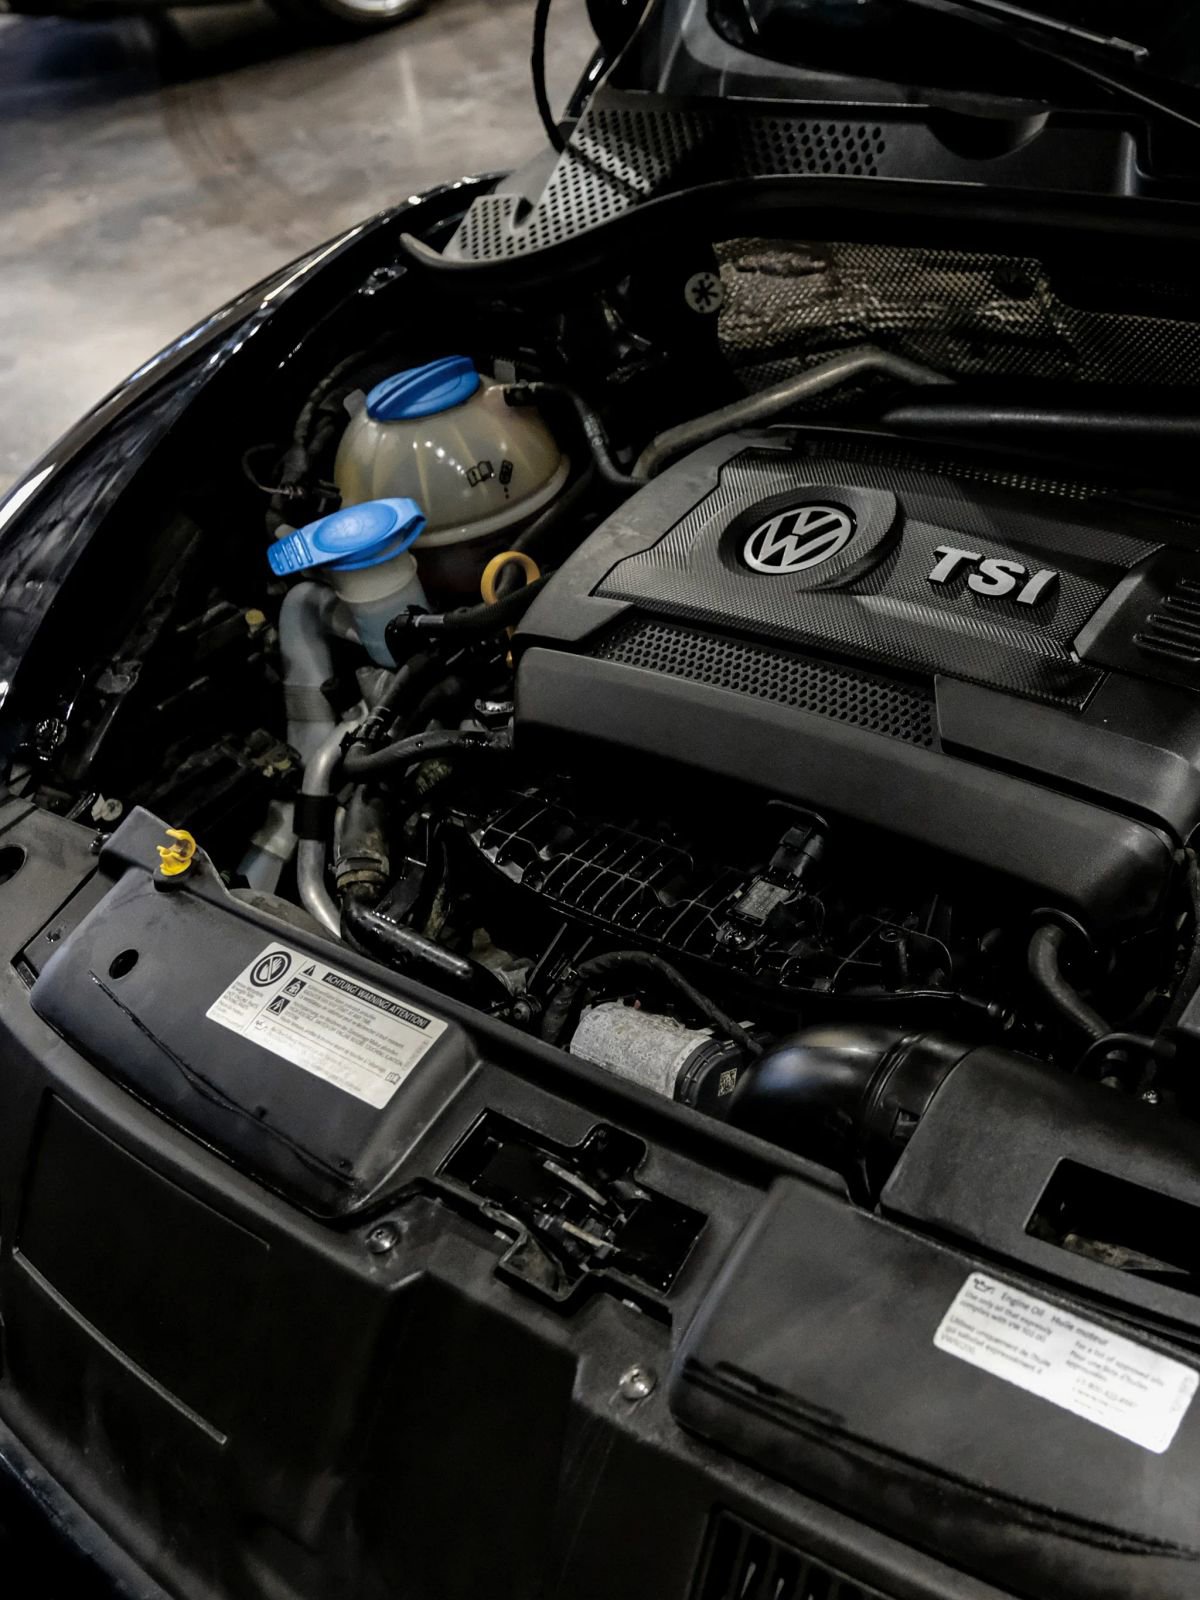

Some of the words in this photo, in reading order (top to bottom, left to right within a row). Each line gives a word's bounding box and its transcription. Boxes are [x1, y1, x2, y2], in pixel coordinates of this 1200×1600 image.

[743, 505, 853, 575] VW
[927, 545, 1059, 606] TSI
[324, 973, 360, 995] ACHTUNG!
[355, 988, 392, 1010] WARNING!
[387, 1003, 428, 1027] ATTENTION!
[999, 1291, 1032, 1312] Engine
[1029, 1305, 1046, 1317] Oil
[1050, 1315, 1075, 1330] Huile
